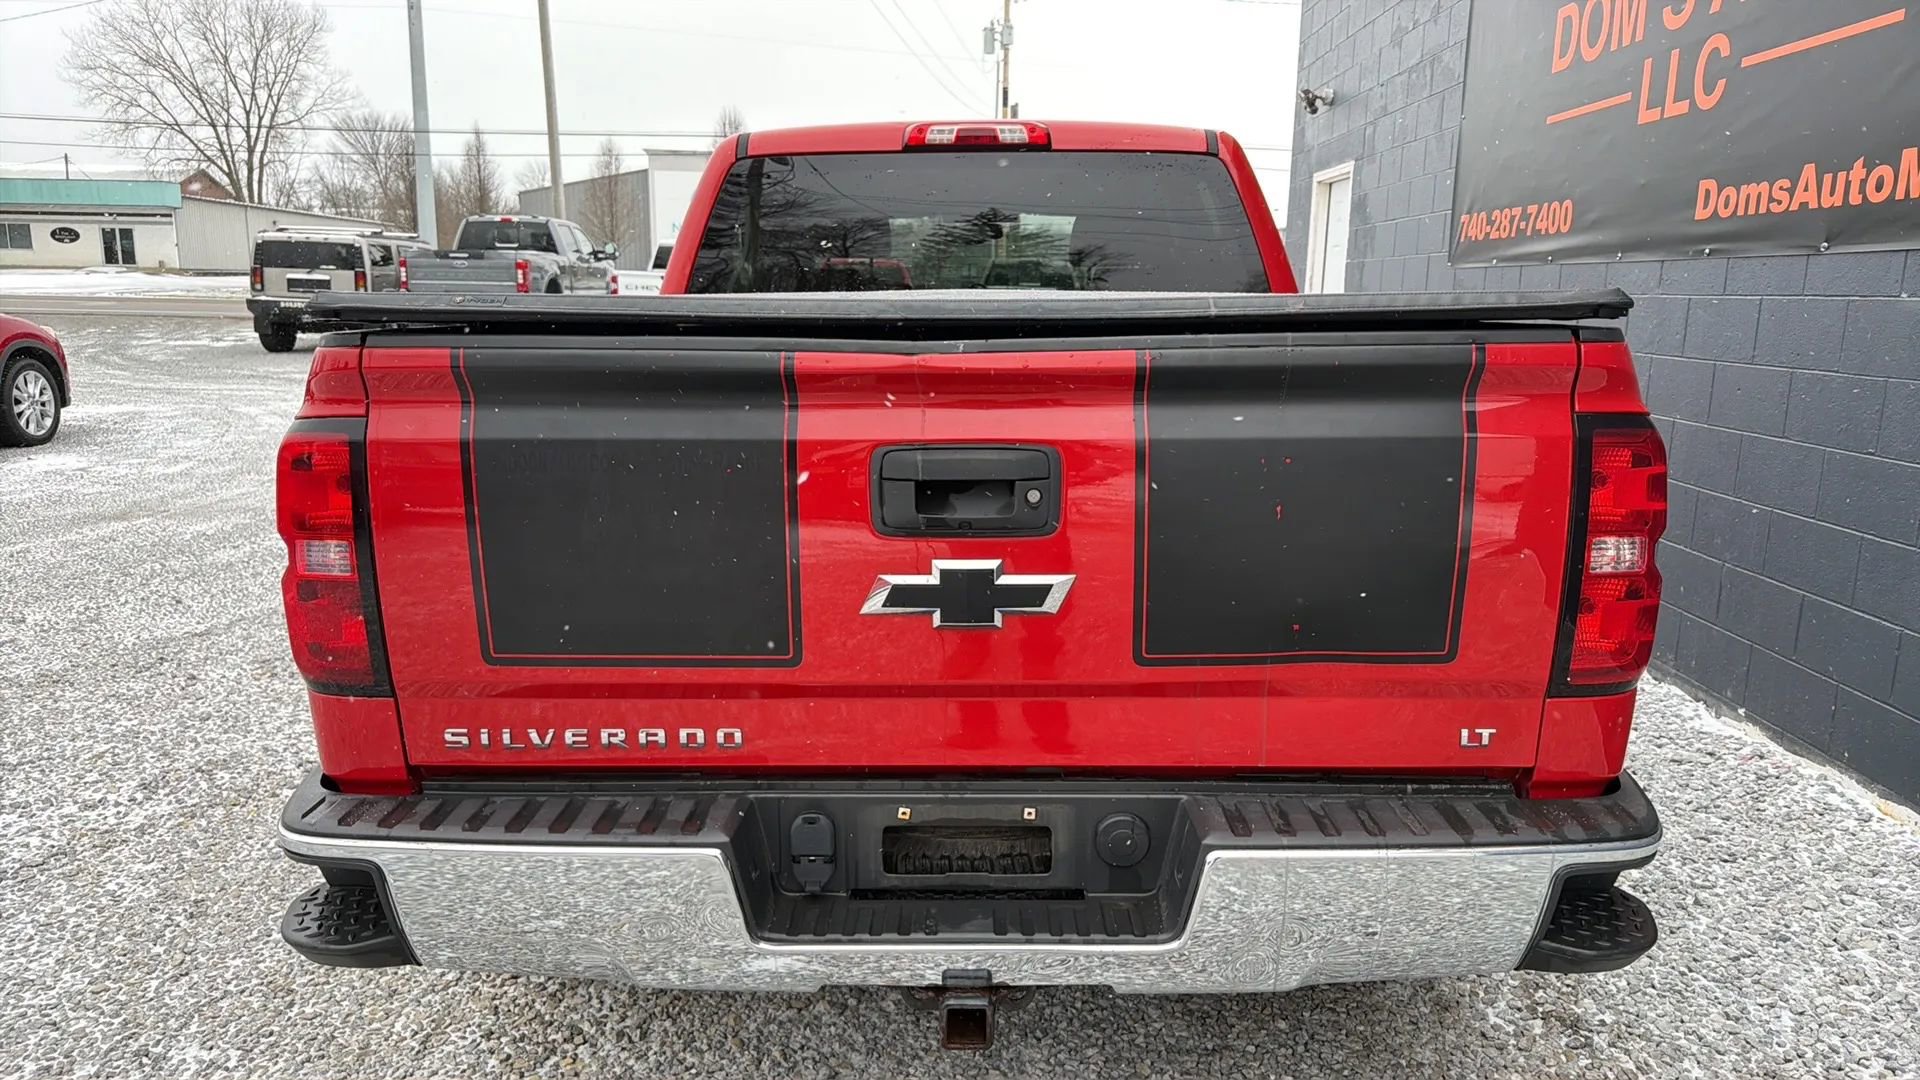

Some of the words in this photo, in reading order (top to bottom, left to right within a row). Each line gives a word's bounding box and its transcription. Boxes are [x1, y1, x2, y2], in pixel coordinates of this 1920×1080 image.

[1552, 0, 1648, 74] DOM
[1638, 32, 1731, 125] LLC
[1460, 199, 1573, 242] 740-287-7400
[444, 728, 744, 748] SILVERADO
[1460, 728, 1497, 748] LT
